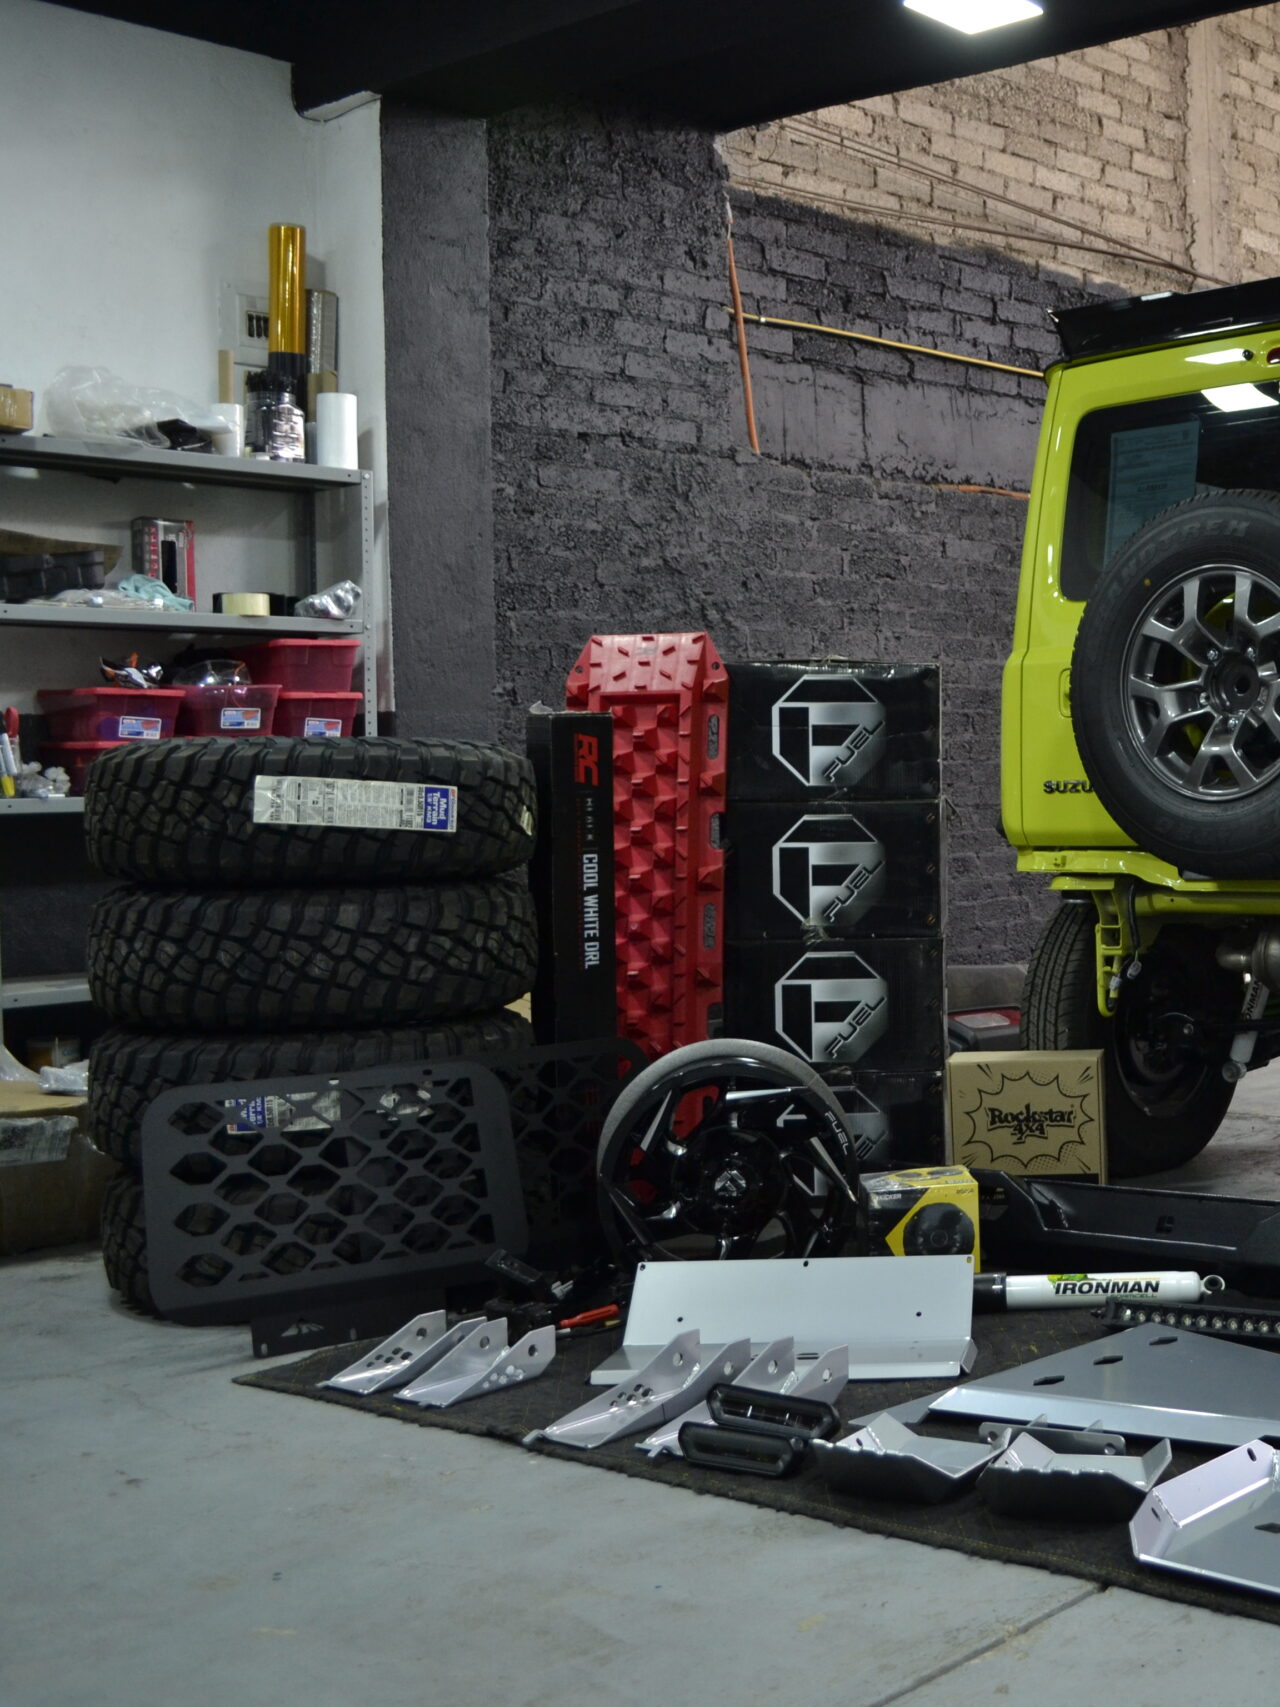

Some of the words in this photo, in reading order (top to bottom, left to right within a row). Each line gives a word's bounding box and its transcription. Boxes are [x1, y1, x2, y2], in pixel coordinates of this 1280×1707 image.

[577, 733, 599, 786] RC
[822, 720, 886, 783] FUEL
[1043, 780, 1093, 794] SUZU
[432, 791, 440, 825] Terrain
[439, 798, 447, 820] Mud
[583, 853, 598, 891] COOL
[822, 860, 886, 923] FUEL
[584, 894, 599, 937] WHITE
[585, 941, 600, 969] DRL
[825, 996, 888, 1059] FUEL
[824, 1111, 849, 1155] FUEL
[988, 1103, 1075, 1126] Rockstar
[1055, 1280, 1160, 1294] IRONMAN
